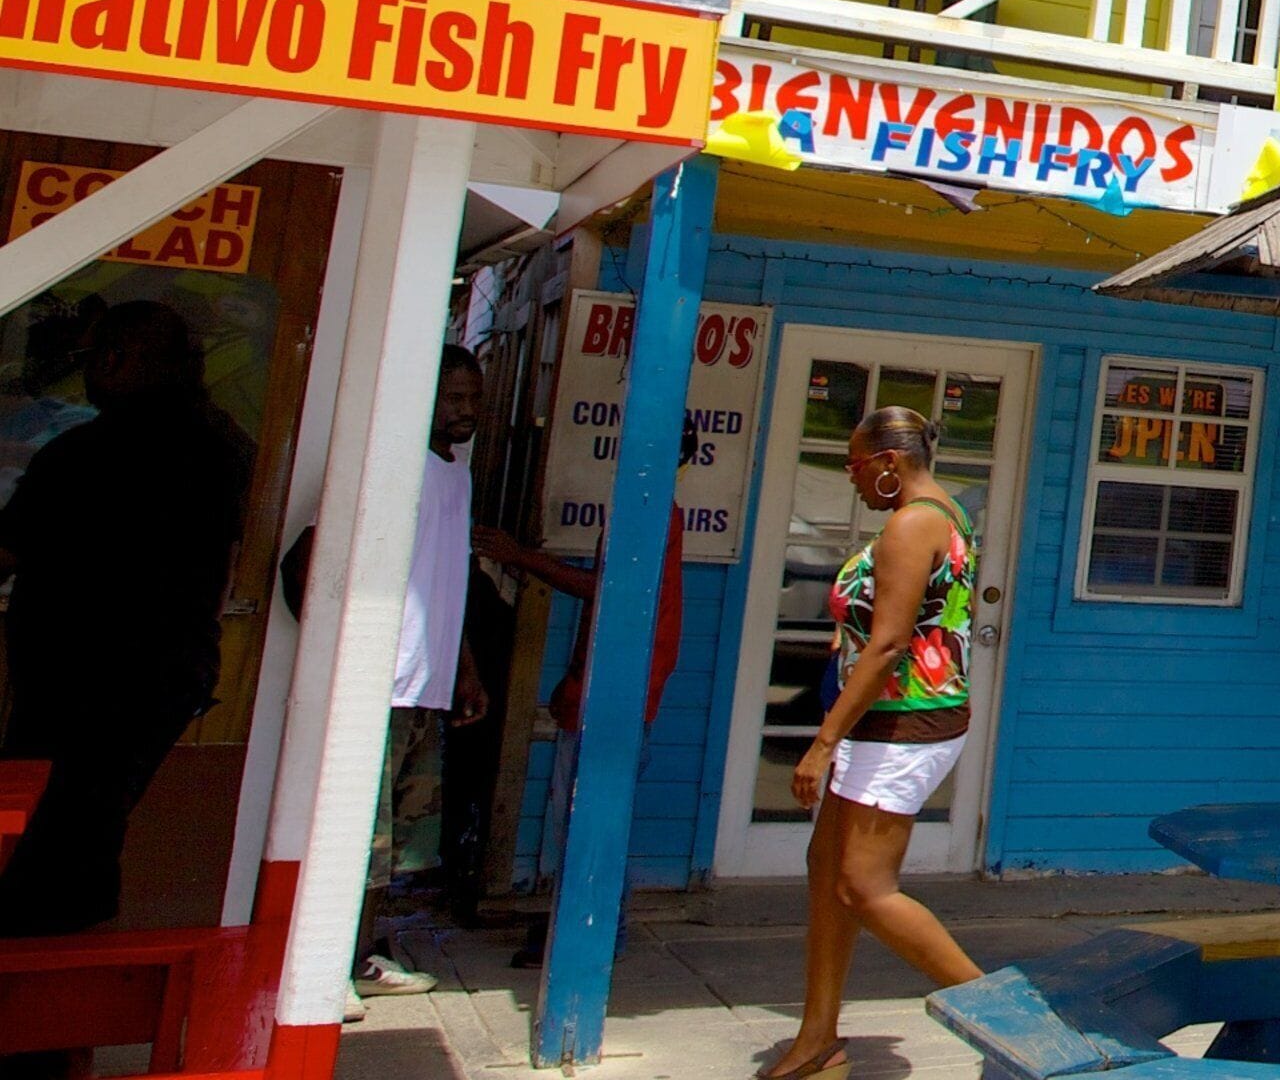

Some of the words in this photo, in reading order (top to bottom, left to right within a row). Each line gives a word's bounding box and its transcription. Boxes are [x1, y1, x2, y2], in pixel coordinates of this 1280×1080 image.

[553, 12, 688, 129] Fry
[710, 58, 1196, 183] BIENVENIDOS
[871, 120, 1022, 179] FISH
[1036, 143, 1155, 194] FRY
[581, 304, 759, 370] BRO'S
